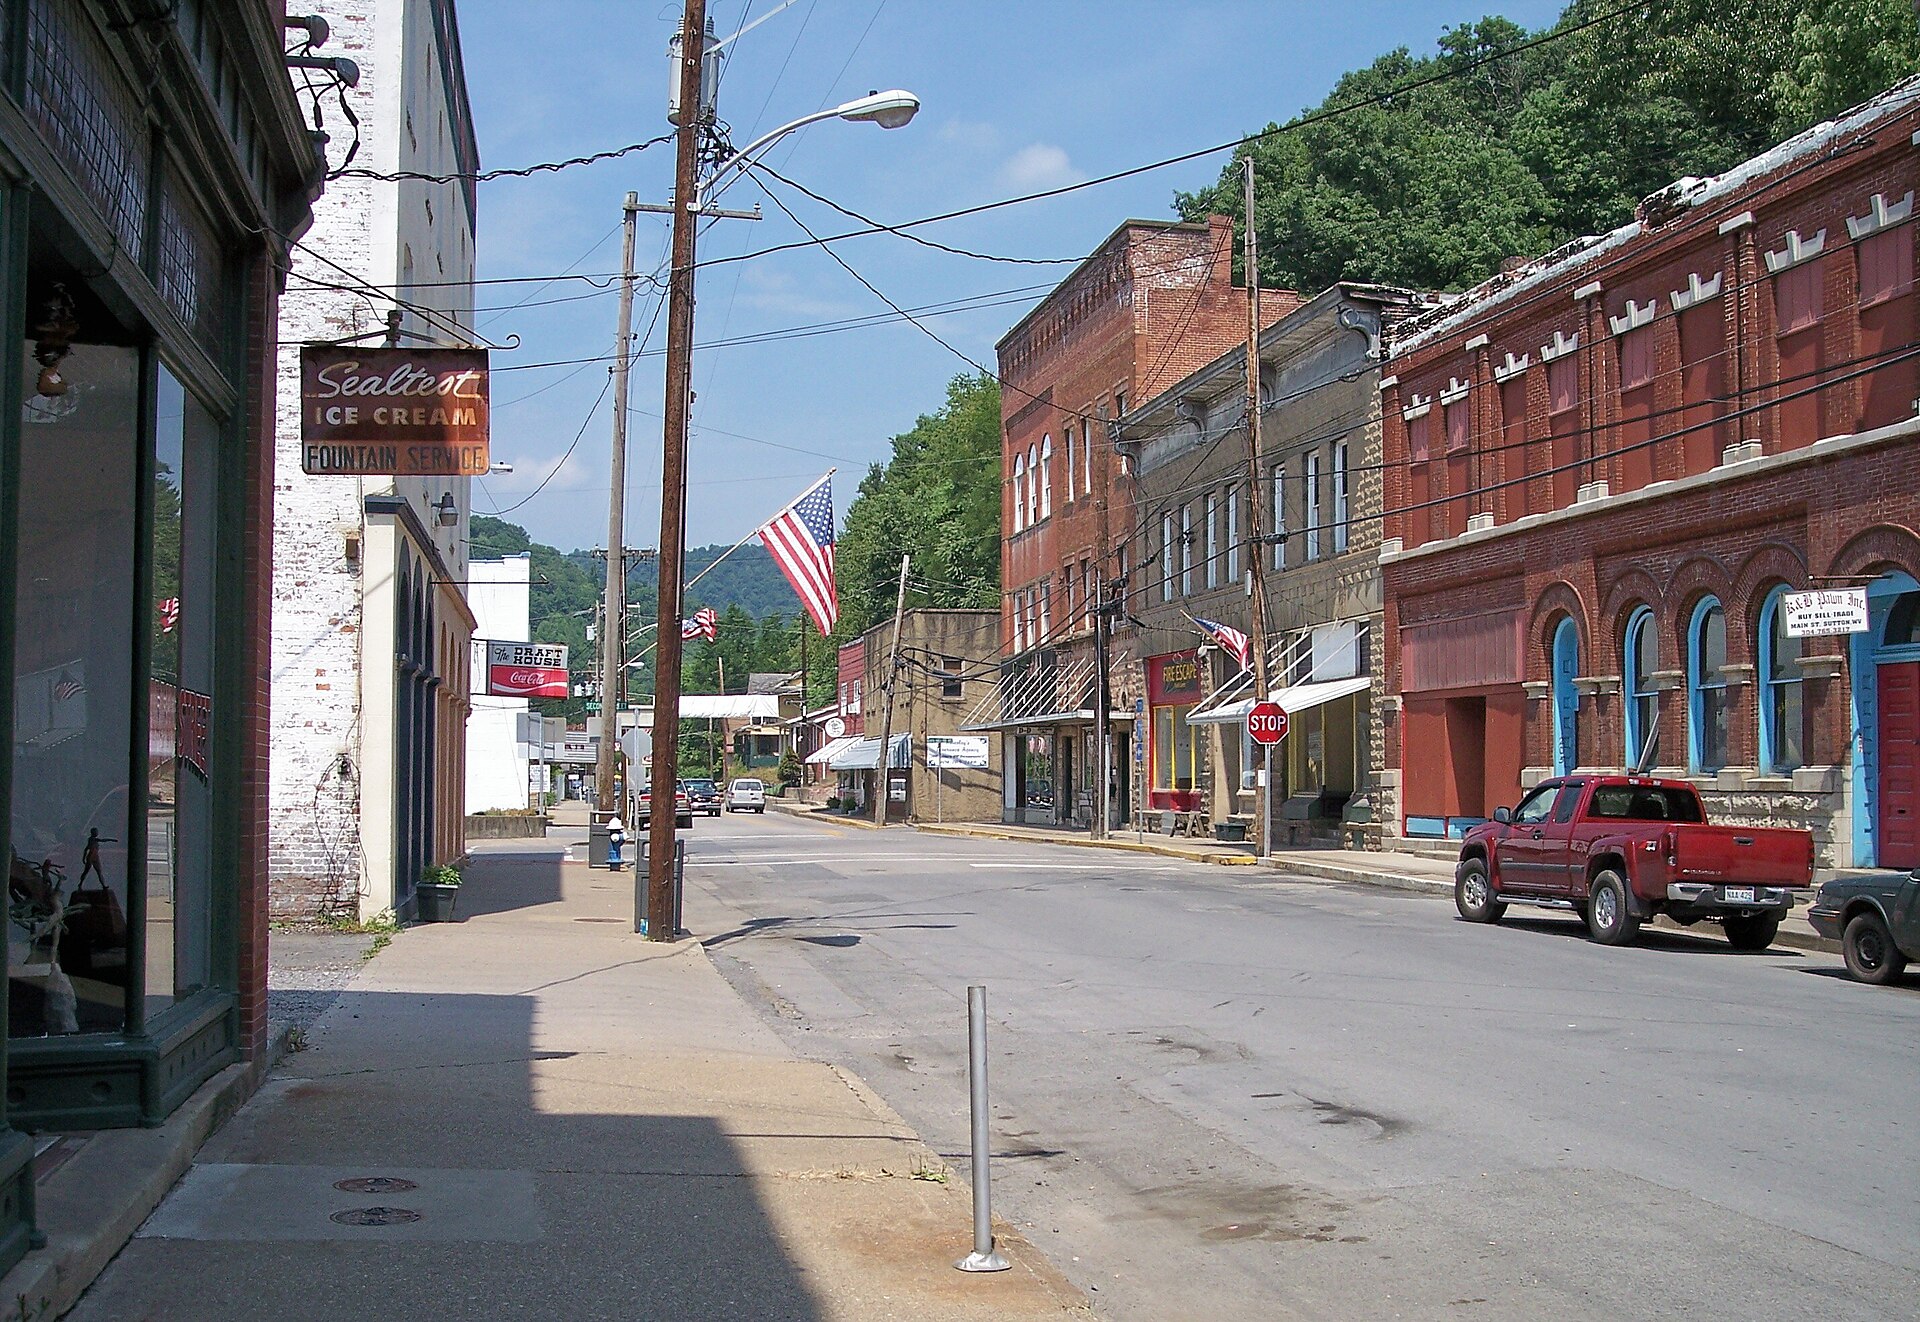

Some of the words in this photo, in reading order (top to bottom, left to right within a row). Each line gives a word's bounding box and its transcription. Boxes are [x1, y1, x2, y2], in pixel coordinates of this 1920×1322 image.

[315, 360, 483, 399] Sealtest
[315, 406, 359, 426] ICE
[373, 406, 477, 426] CREAM
[307, 445, 398, 471] FOUNTAIN
[407, 445, 484, 471] SERVICE
[1817, 591, 1843, 609] Pawn
[1847, 592, 1865, 610] Inc.
[494, 646, 510, 661] The
[513, 647, 563, 658] DRAFT
[513, 656, 562, 667] HOUSE
[1175, 663, 1197, 681] ESCAPE
[1250, 715, 1286, 731] STOP
